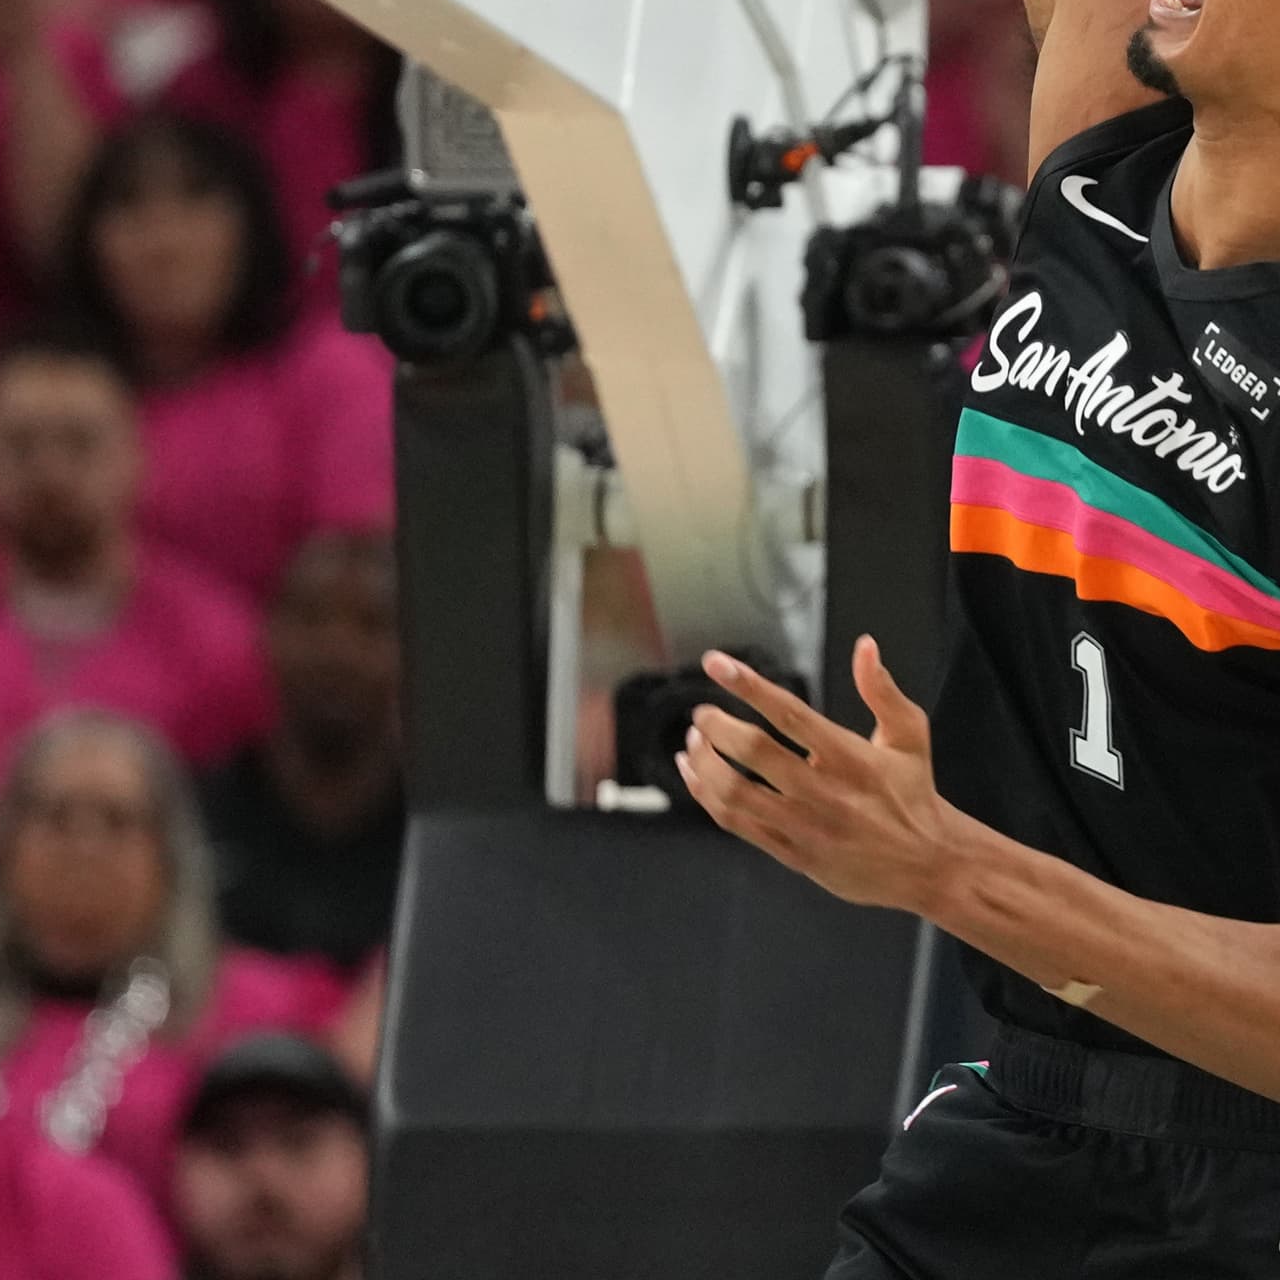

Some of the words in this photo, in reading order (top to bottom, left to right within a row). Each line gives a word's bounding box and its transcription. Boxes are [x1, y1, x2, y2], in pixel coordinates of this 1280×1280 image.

[971, 291, 1070, 396] San
[1064, 331, 1247, 494] Antonio
[1203, 339, 1269, 402] LEDGER
[1070, 631, 1125, 791] 1
